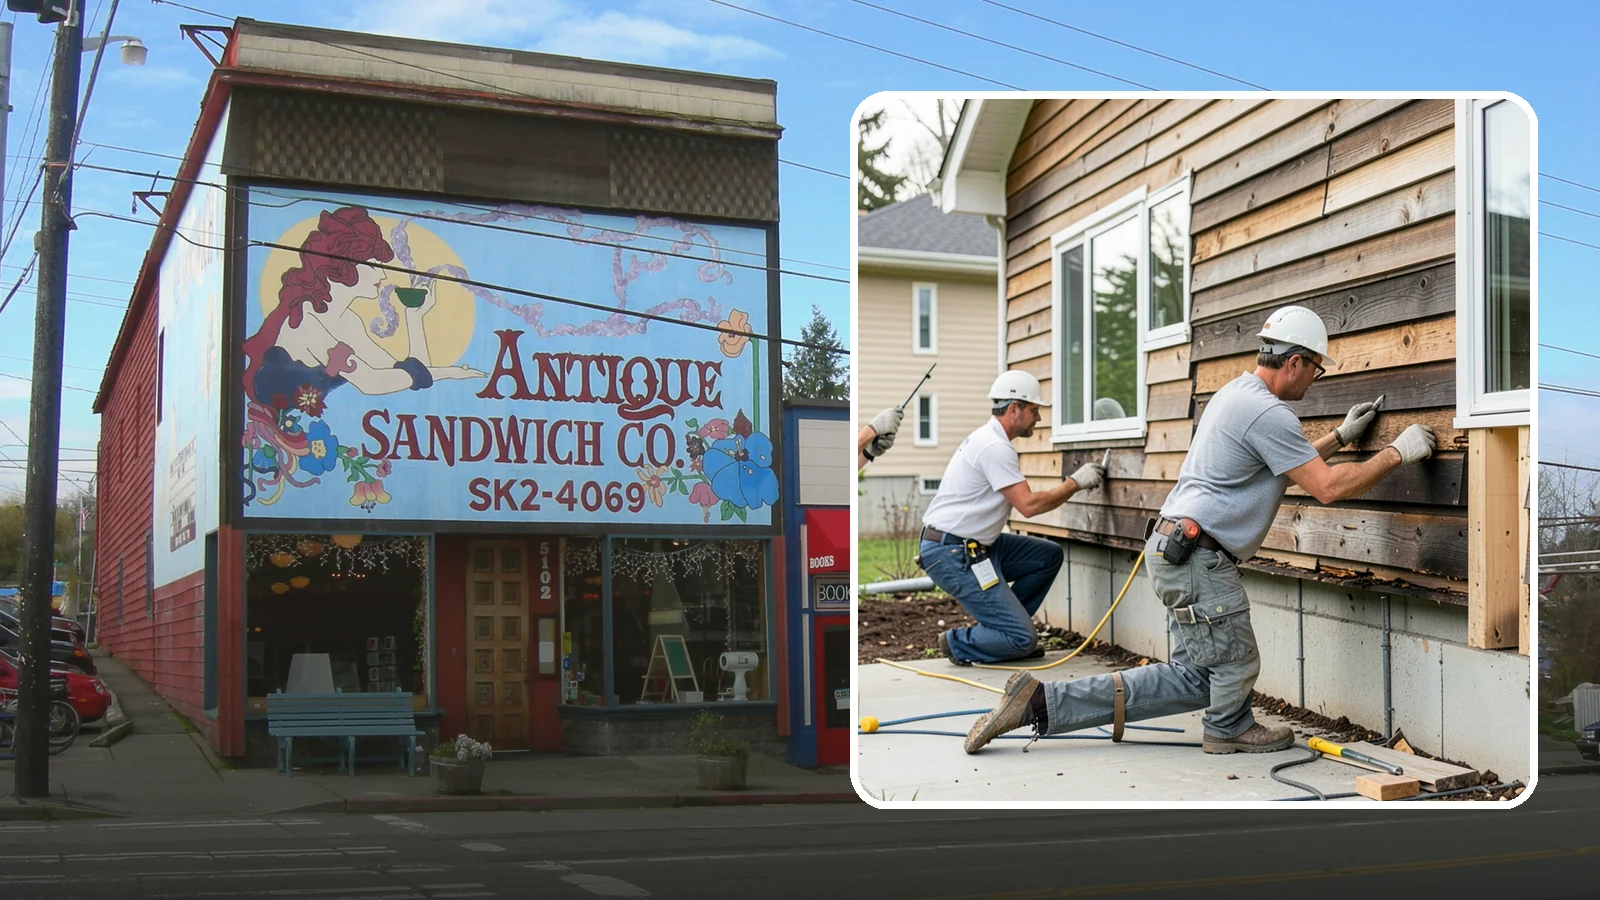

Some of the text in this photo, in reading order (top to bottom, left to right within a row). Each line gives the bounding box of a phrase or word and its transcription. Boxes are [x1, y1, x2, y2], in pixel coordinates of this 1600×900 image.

[476, 329, 724, 421] ANTIQUE
[361, 408, 684, 468] SANDWICH CO.
[468, 476, 645, 514] SK2-4069
[540, 541, 551, 600] 5102
[809, 555, 835, 569] BOOKS
